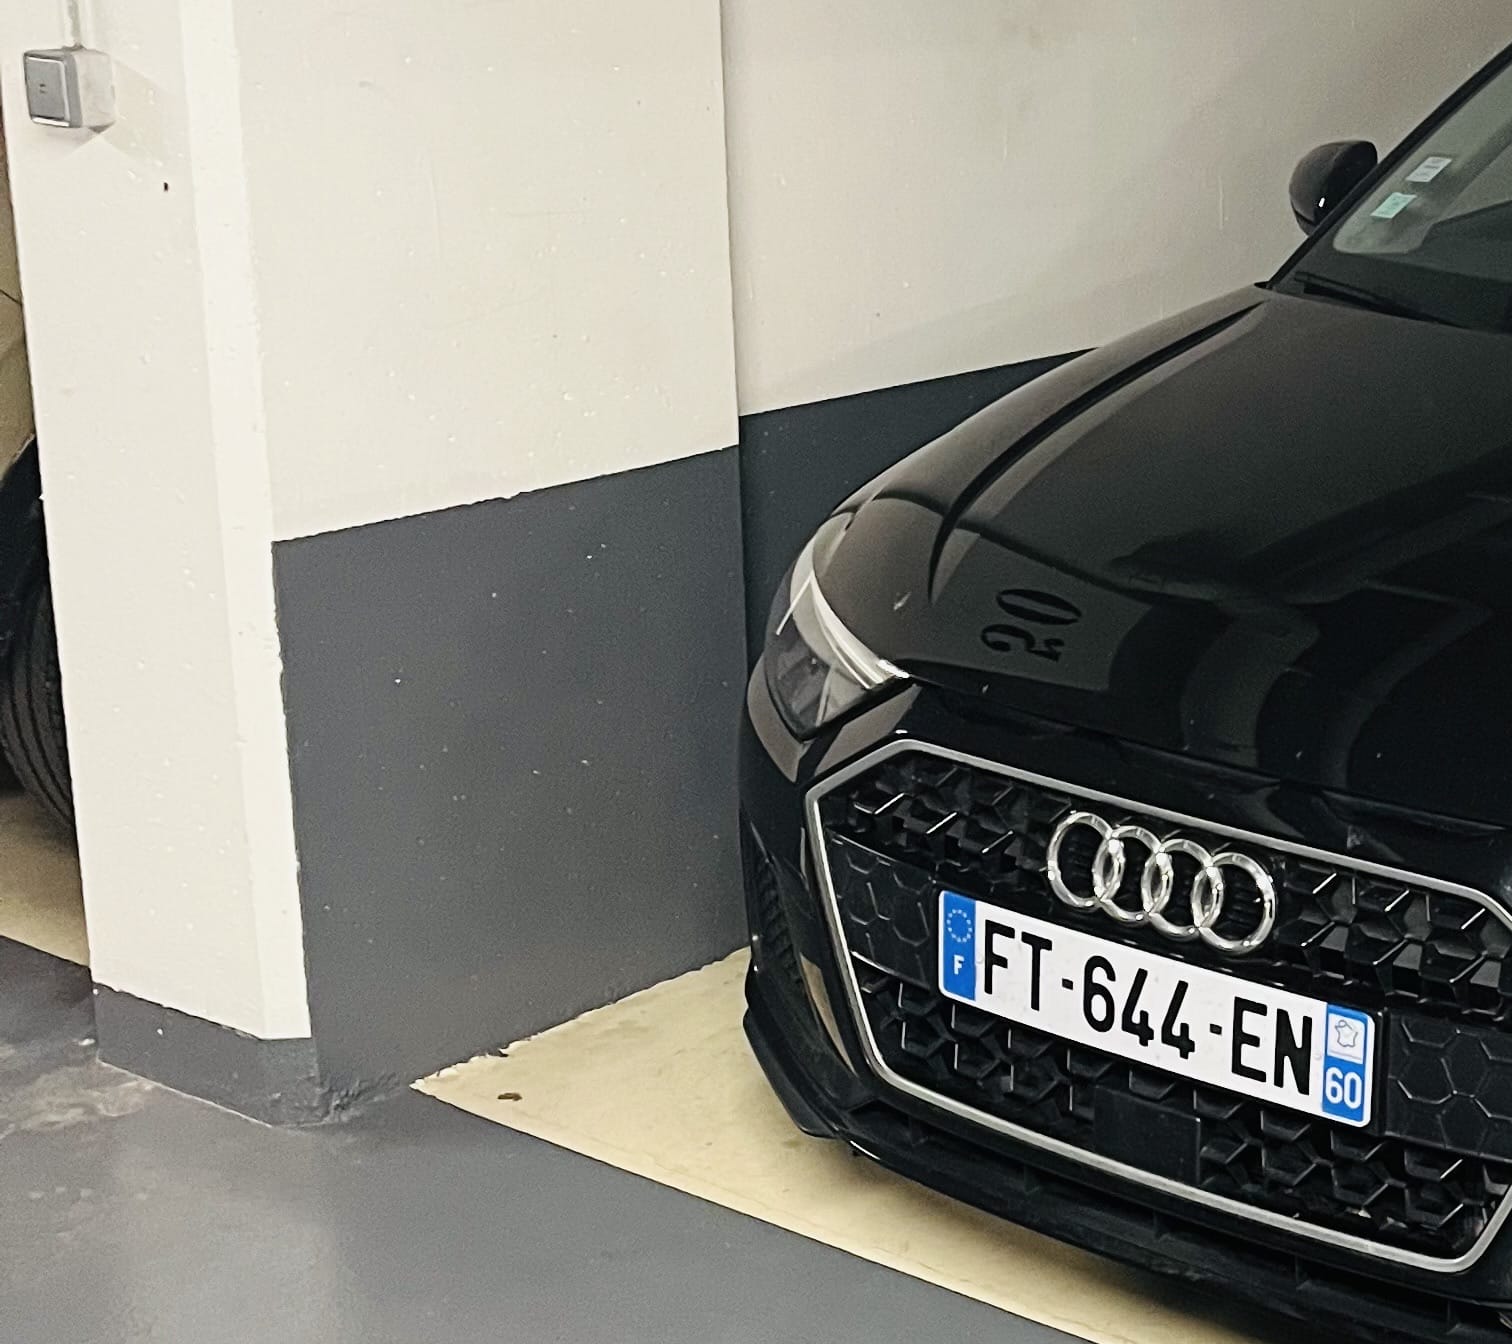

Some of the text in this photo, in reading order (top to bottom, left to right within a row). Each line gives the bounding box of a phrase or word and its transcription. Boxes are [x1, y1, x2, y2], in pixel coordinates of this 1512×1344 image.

[953, 954, 965, 976] F
[983, 919, 1313, 1096] FT-644-EN
[1325, 1068, 1363, 1110] 60
